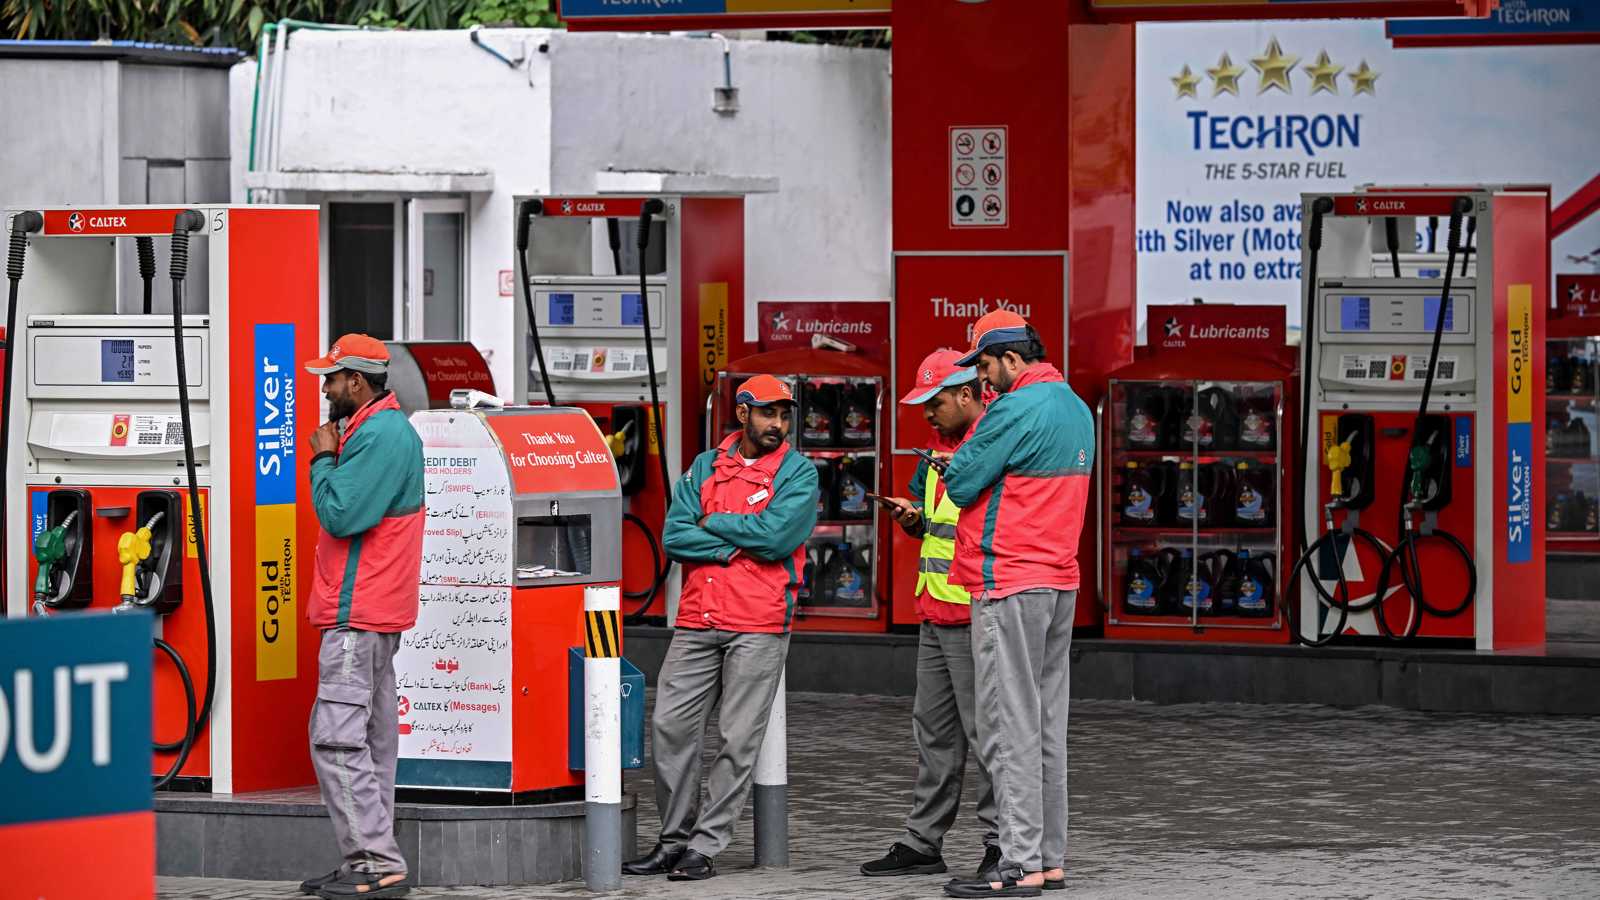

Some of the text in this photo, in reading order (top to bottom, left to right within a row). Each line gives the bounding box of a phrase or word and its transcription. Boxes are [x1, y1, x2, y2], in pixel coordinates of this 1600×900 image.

[1498, 7, 1570, 26] TECHRON
[1186, 111, 1361, 156] TECHRON
[1204, 162, 1347, 181] THE 5-STAR FUEL
[576, 203, 606, 212] CALTEX
[1167, 200, 1213, 223] Now
[1220, 199, 1264, 223] also
[1373, 201, 1406, 210] CALTEX
[89, 216, 127, 228] CALTEX
[213, 213, 224, 232] 5
[1136, 229, 1166, 252] ith
[1174, 228, 1235, 251] Silver
[1190, 258, 1212, 281] at
[1220, 262, 1246, 280] no
[930, 298, 989, 317] Thank
[795, 319, 873, 334] Lubricants
[1189, 324, 1270, 339] Lubricants
[703, 324, 716, 386] Gold
[1510, 329, 1522, 394] Gold
[258, 356, 281, 476] Silver
[284, 377, 295, 457] TECHRON
[521, 431, 576, 446] Thank You
[423, 457, 478, 467] EDIT DEBIT
[510, 450, 609, 469] for Choosing Caltex
[424, 467, 473, 475] ARD HOLDERS
[1508, 448, 1522, 544] Silver
[34, 514, 43, 542] lver
[283, 538, 292, 605] TECHRON
[261, 560, 279, 644] Gold
[467, 682, 492, 692] (Bank)
[413, 702, 442, 711] CALTEX
[449, 701, 501, 714] (Messages)
[0, 661, 129, 774] UT
